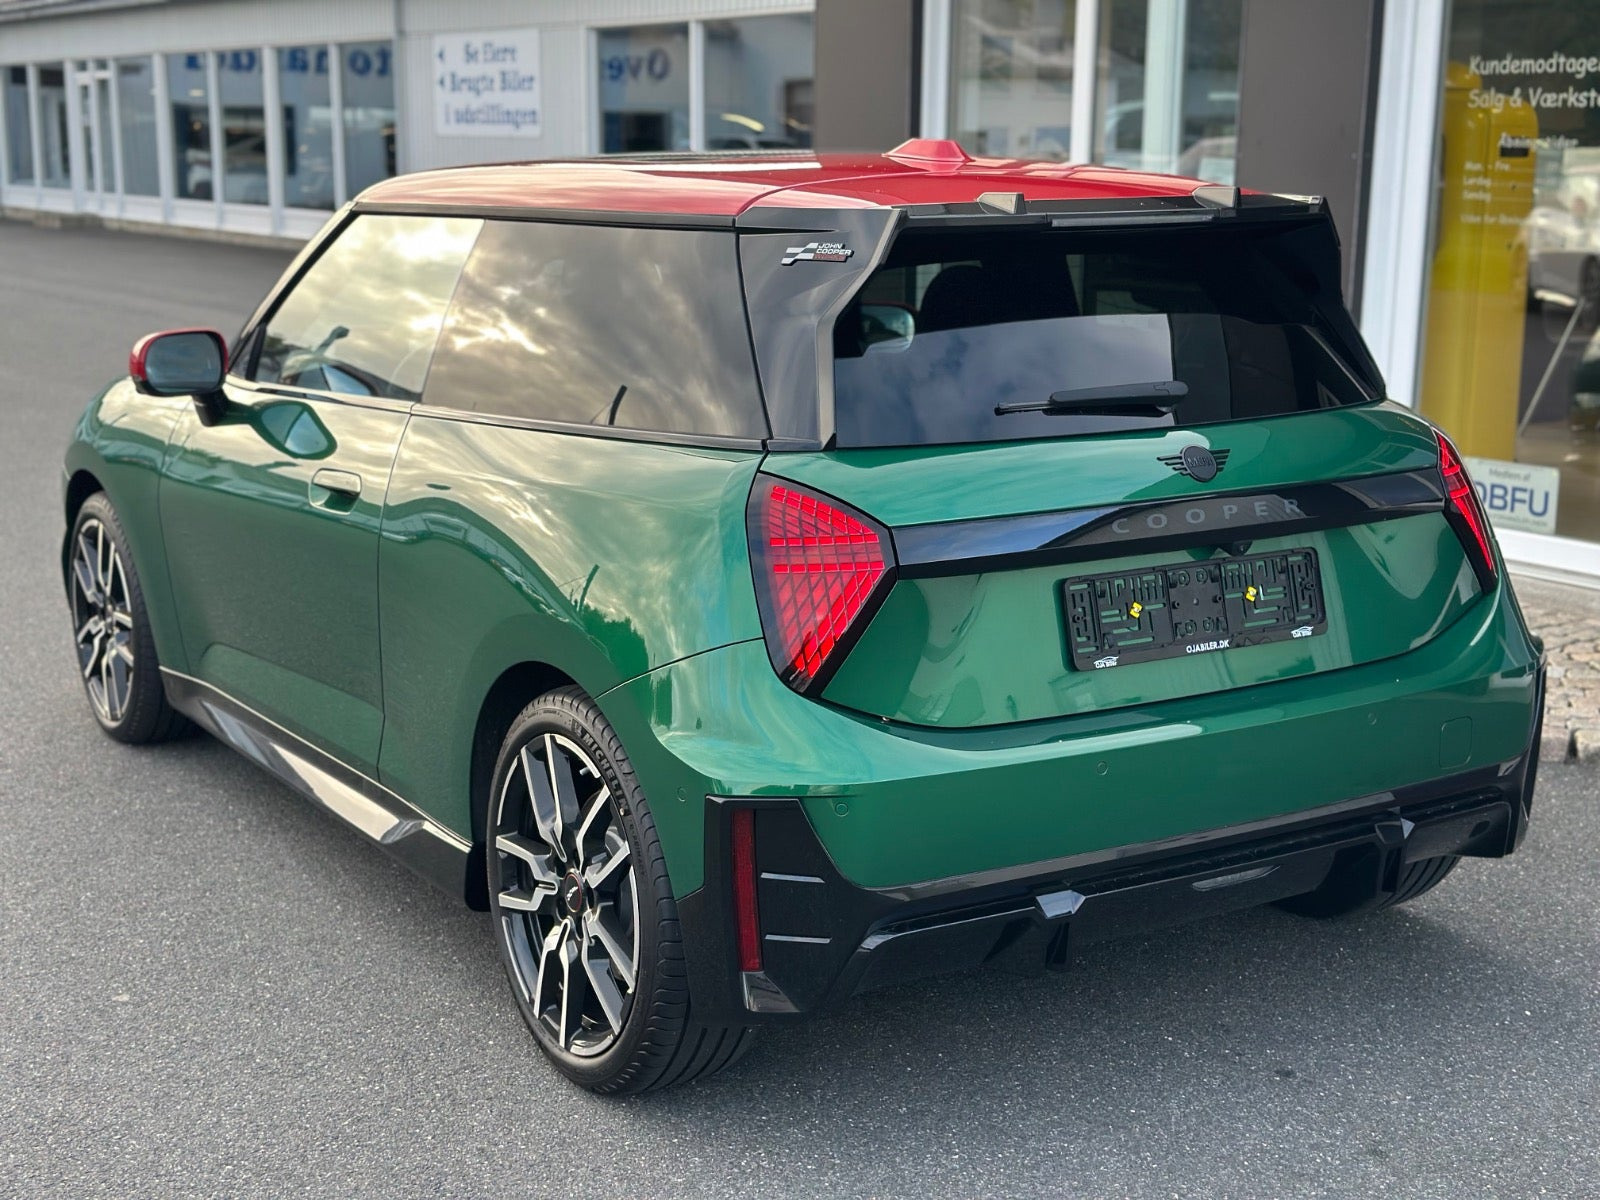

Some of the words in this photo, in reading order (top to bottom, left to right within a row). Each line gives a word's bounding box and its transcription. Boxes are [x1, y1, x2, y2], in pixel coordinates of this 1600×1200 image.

[1468, 50, 1600, 79] Kundemodtage
[1467, 86, 1504, 113] Salg
[1508, 86, 1523, 108] &
[816, 248, 852, 256] COOPER
[1111, 499, 1301, 534] COOPER
[1185, 639, 1230, 654] OJABILER.DK
[583, 731, 630, 816] MICHELIN
